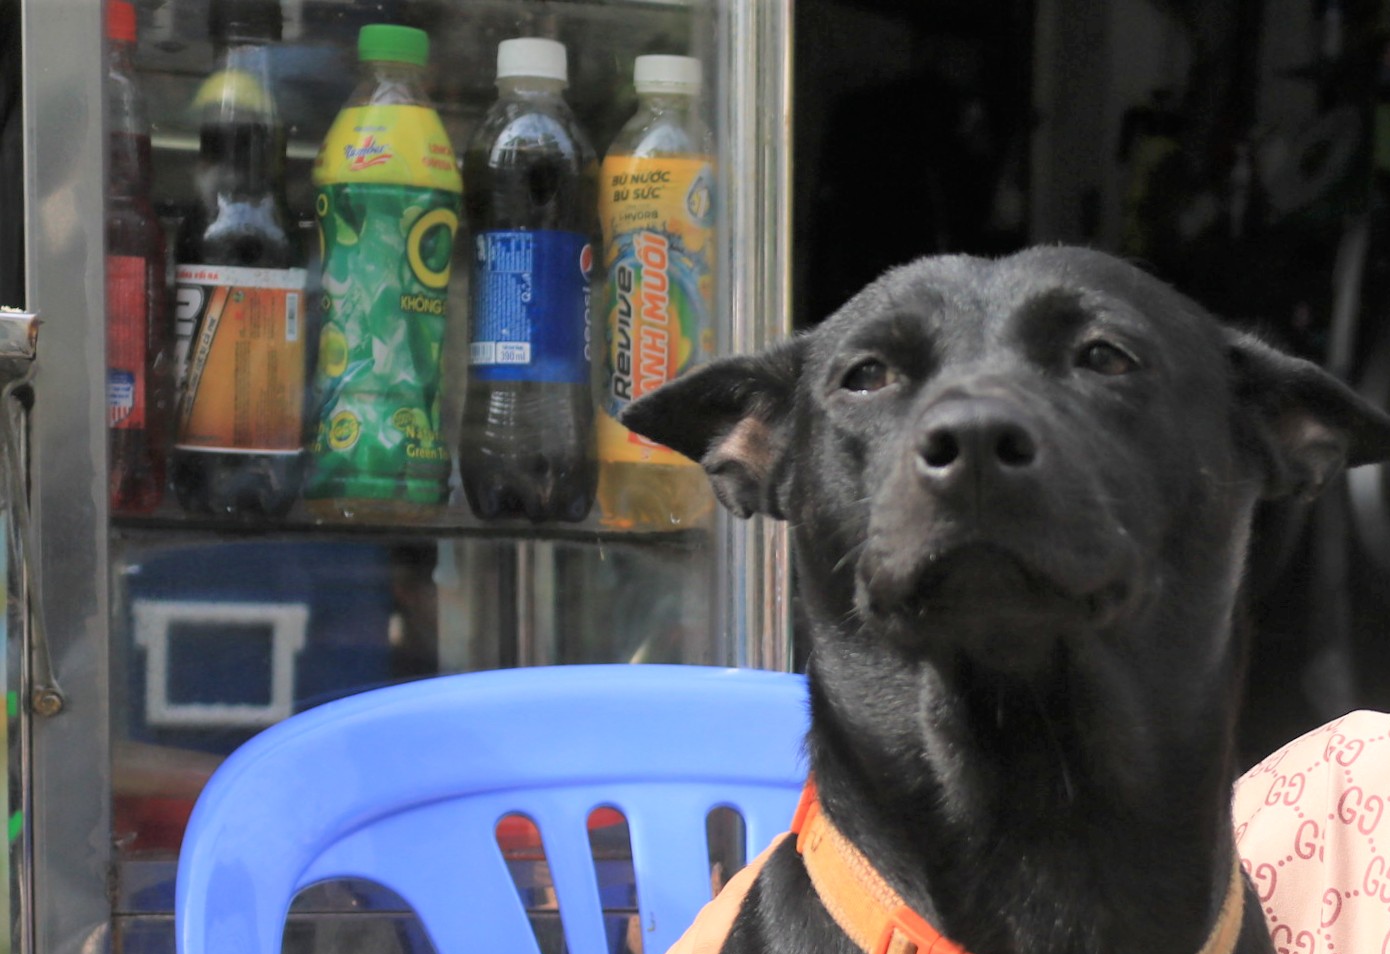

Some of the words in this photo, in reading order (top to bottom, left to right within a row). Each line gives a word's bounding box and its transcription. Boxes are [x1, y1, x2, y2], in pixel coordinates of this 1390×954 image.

[400, 293, 443, 316] KHÔNG
[635, 232, 668, 326] MUỐI
[613, 265, 633, 402] Revive
